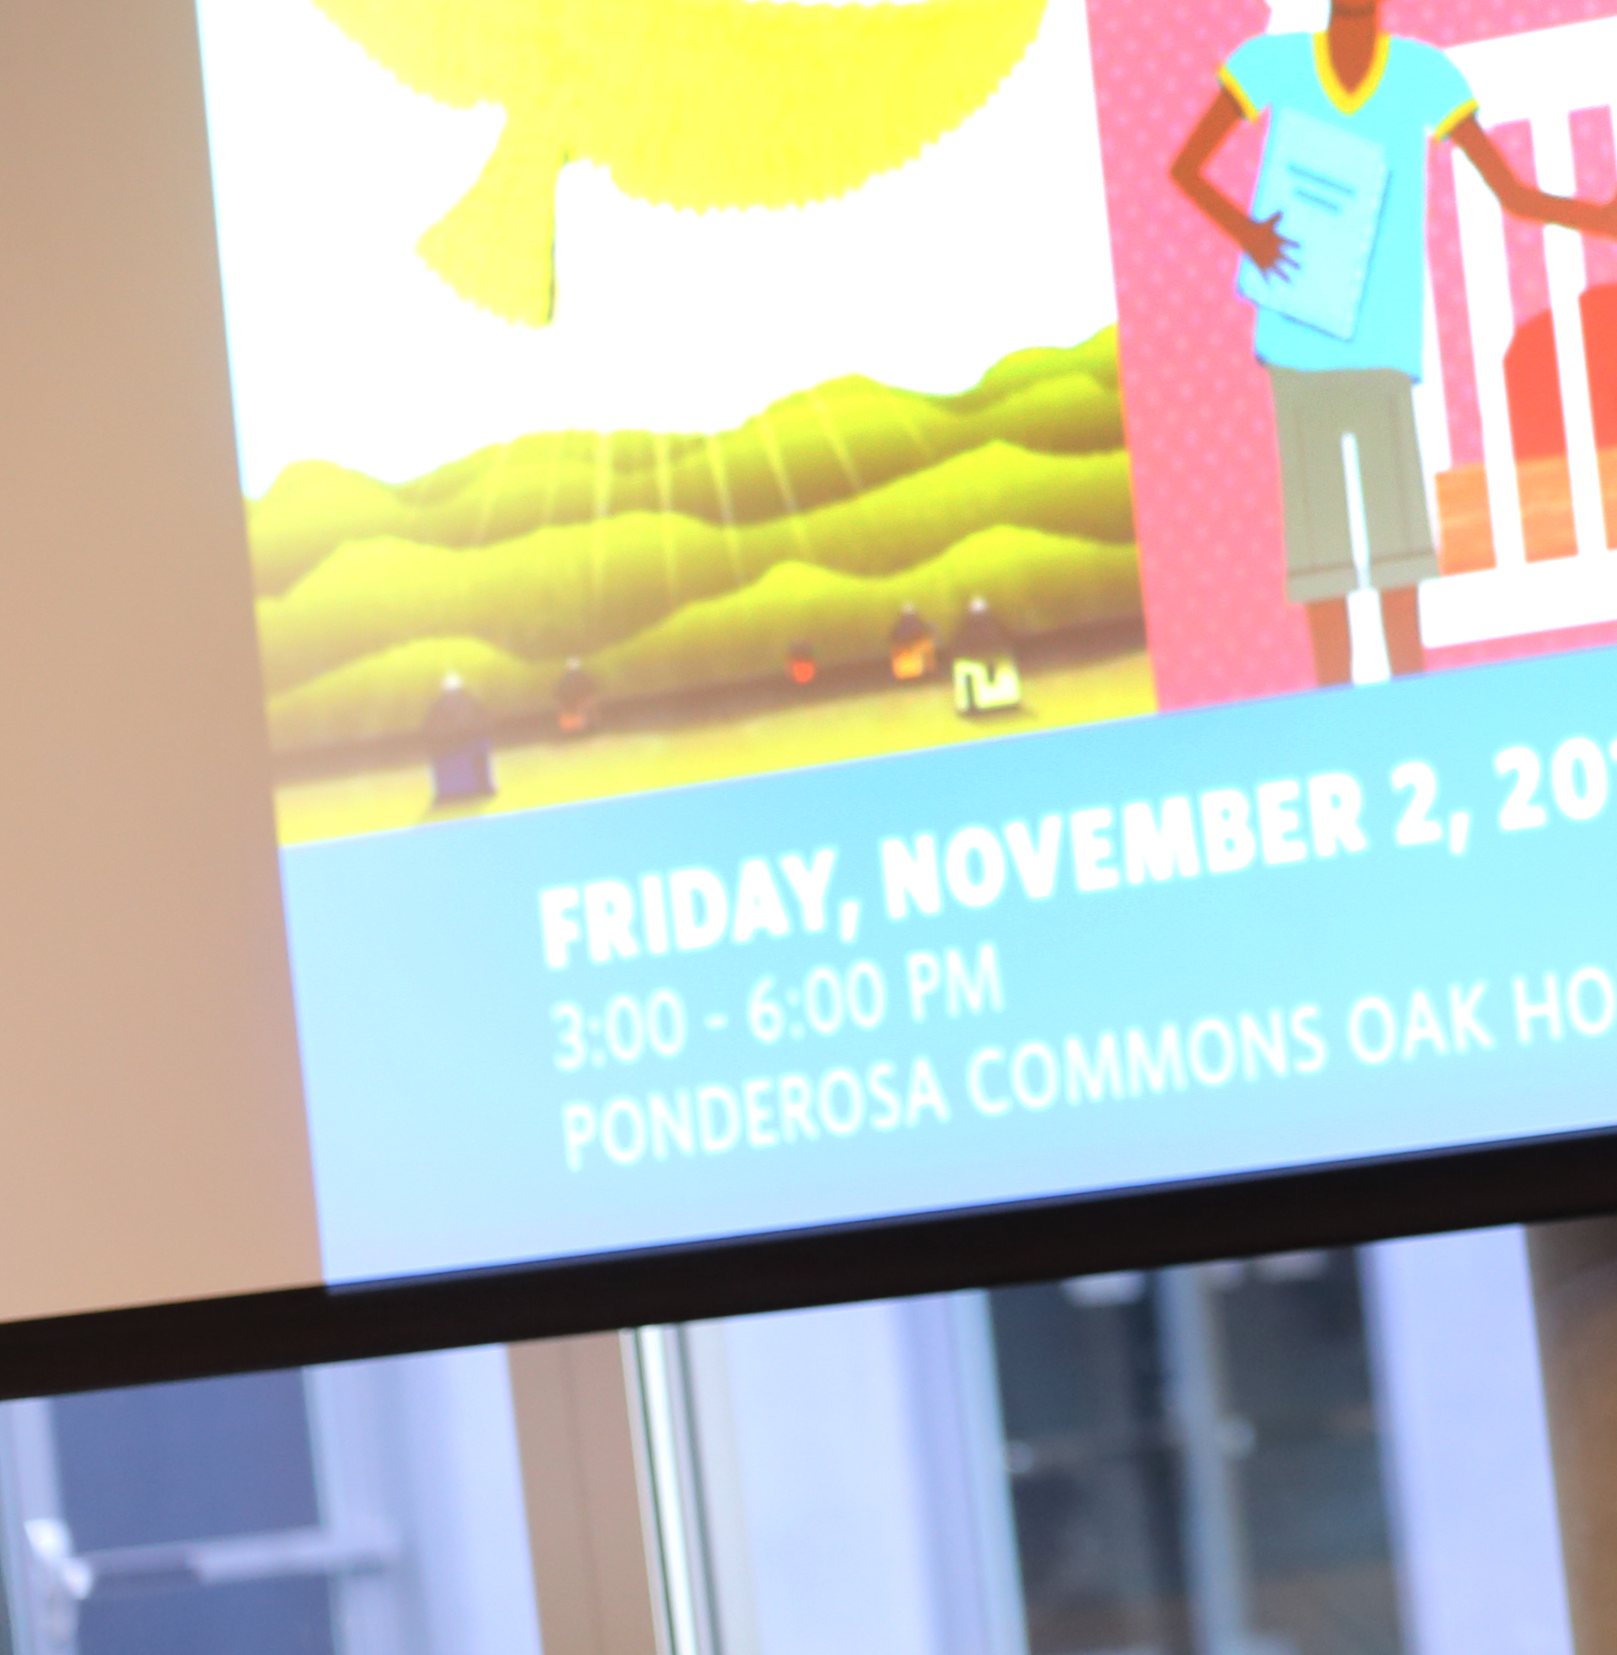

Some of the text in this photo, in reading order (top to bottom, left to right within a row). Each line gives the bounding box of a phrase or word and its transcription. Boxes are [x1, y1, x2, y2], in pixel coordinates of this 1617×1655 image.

[539, 847, 861, 968] FRIDAY,
[880, 771, 1368, 921] NOVEMBER
[1390, 760, 1471, 855] 2,
[553, 989, 686, 1071] 3:00
[746, 960, 886, 1044] 6:00
[906, 943, 1003, 1020] PM
[562, 1057, 950, 1169] PONDEROSA
[967, 1003, 1327, 1116] COMMONS
[1347, 982, 1494, 1066] OAK
